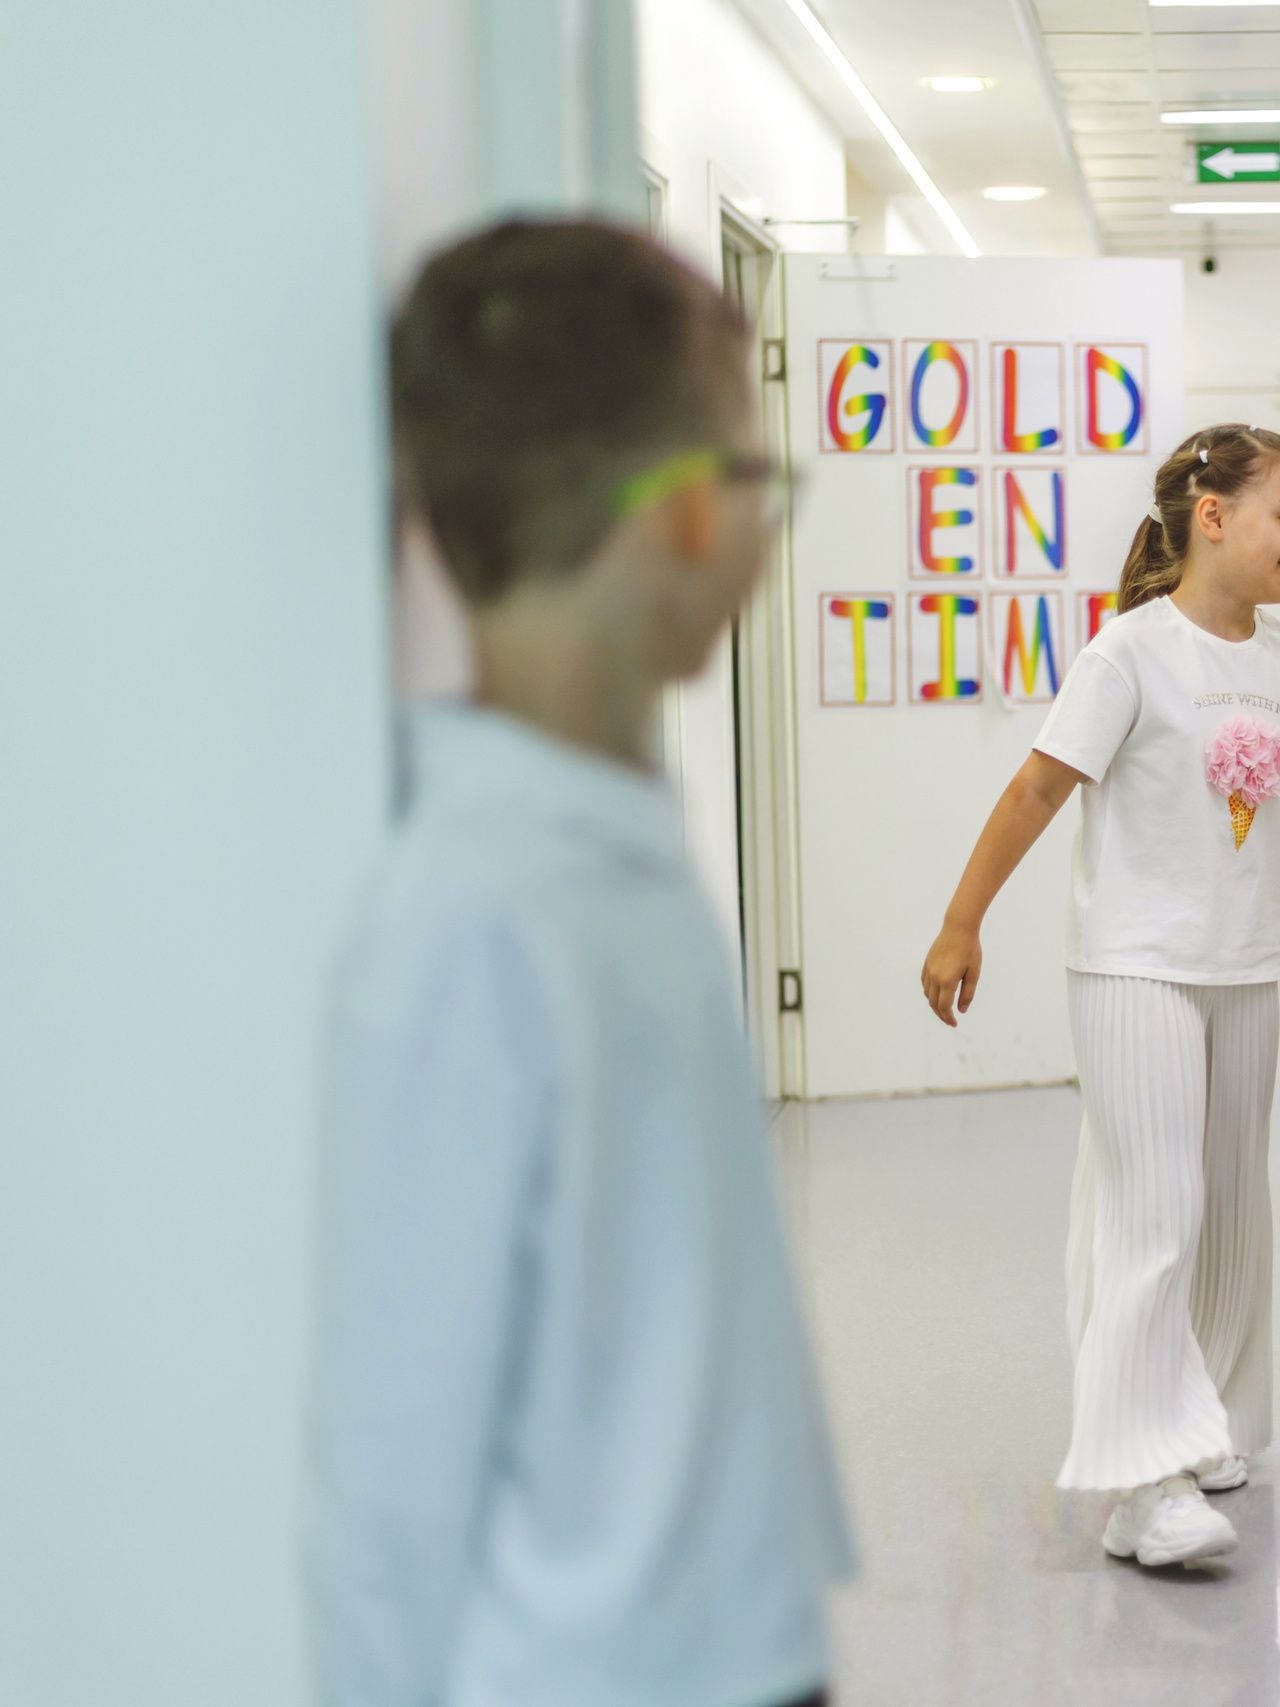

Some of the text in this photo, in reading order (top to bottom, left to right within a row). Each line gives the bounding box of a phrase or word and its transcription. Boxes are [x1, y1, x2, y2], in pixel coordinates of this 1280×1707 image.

[828, 342, 1144, 452] GOLD
[919, 467, 1064, 576] EN
[830, 592, 1118, 704] TIM
[1236, 693, 1274, 711] WITH
